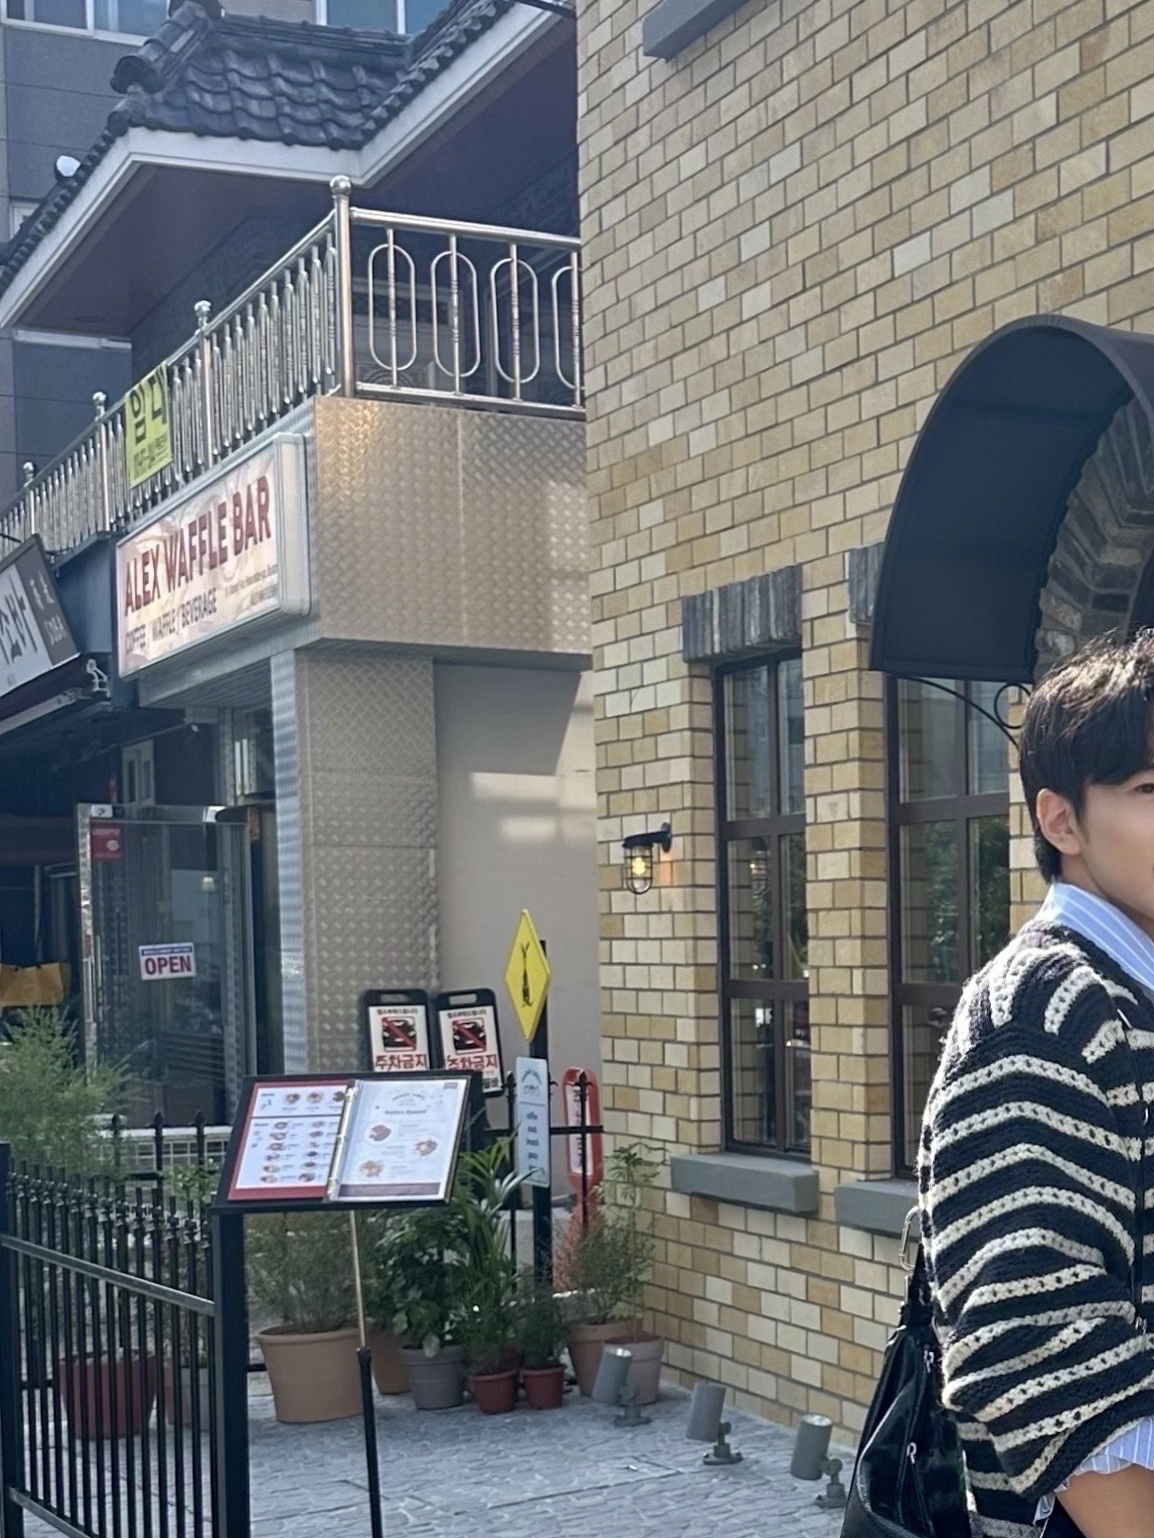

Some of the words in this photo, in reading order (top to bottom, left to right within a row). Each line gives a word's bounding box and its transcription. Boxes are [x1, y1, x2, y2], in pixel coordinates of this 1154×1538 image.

[130, 365, 168, 445] 임대
[125, 543, 160, 616] ALEX
[164, 501, 229, 594] WAFFLE
[232, 475, 271, 557] BAR
[126, 624, 146, 655] COFFEE
[152, 609, 176, 642] WAFFLE
[181, 588, 217, 627] BEVERAGE
[144, 955, 192, 976] OPEN
[375, 1053, 428, 1071] 주차금지
